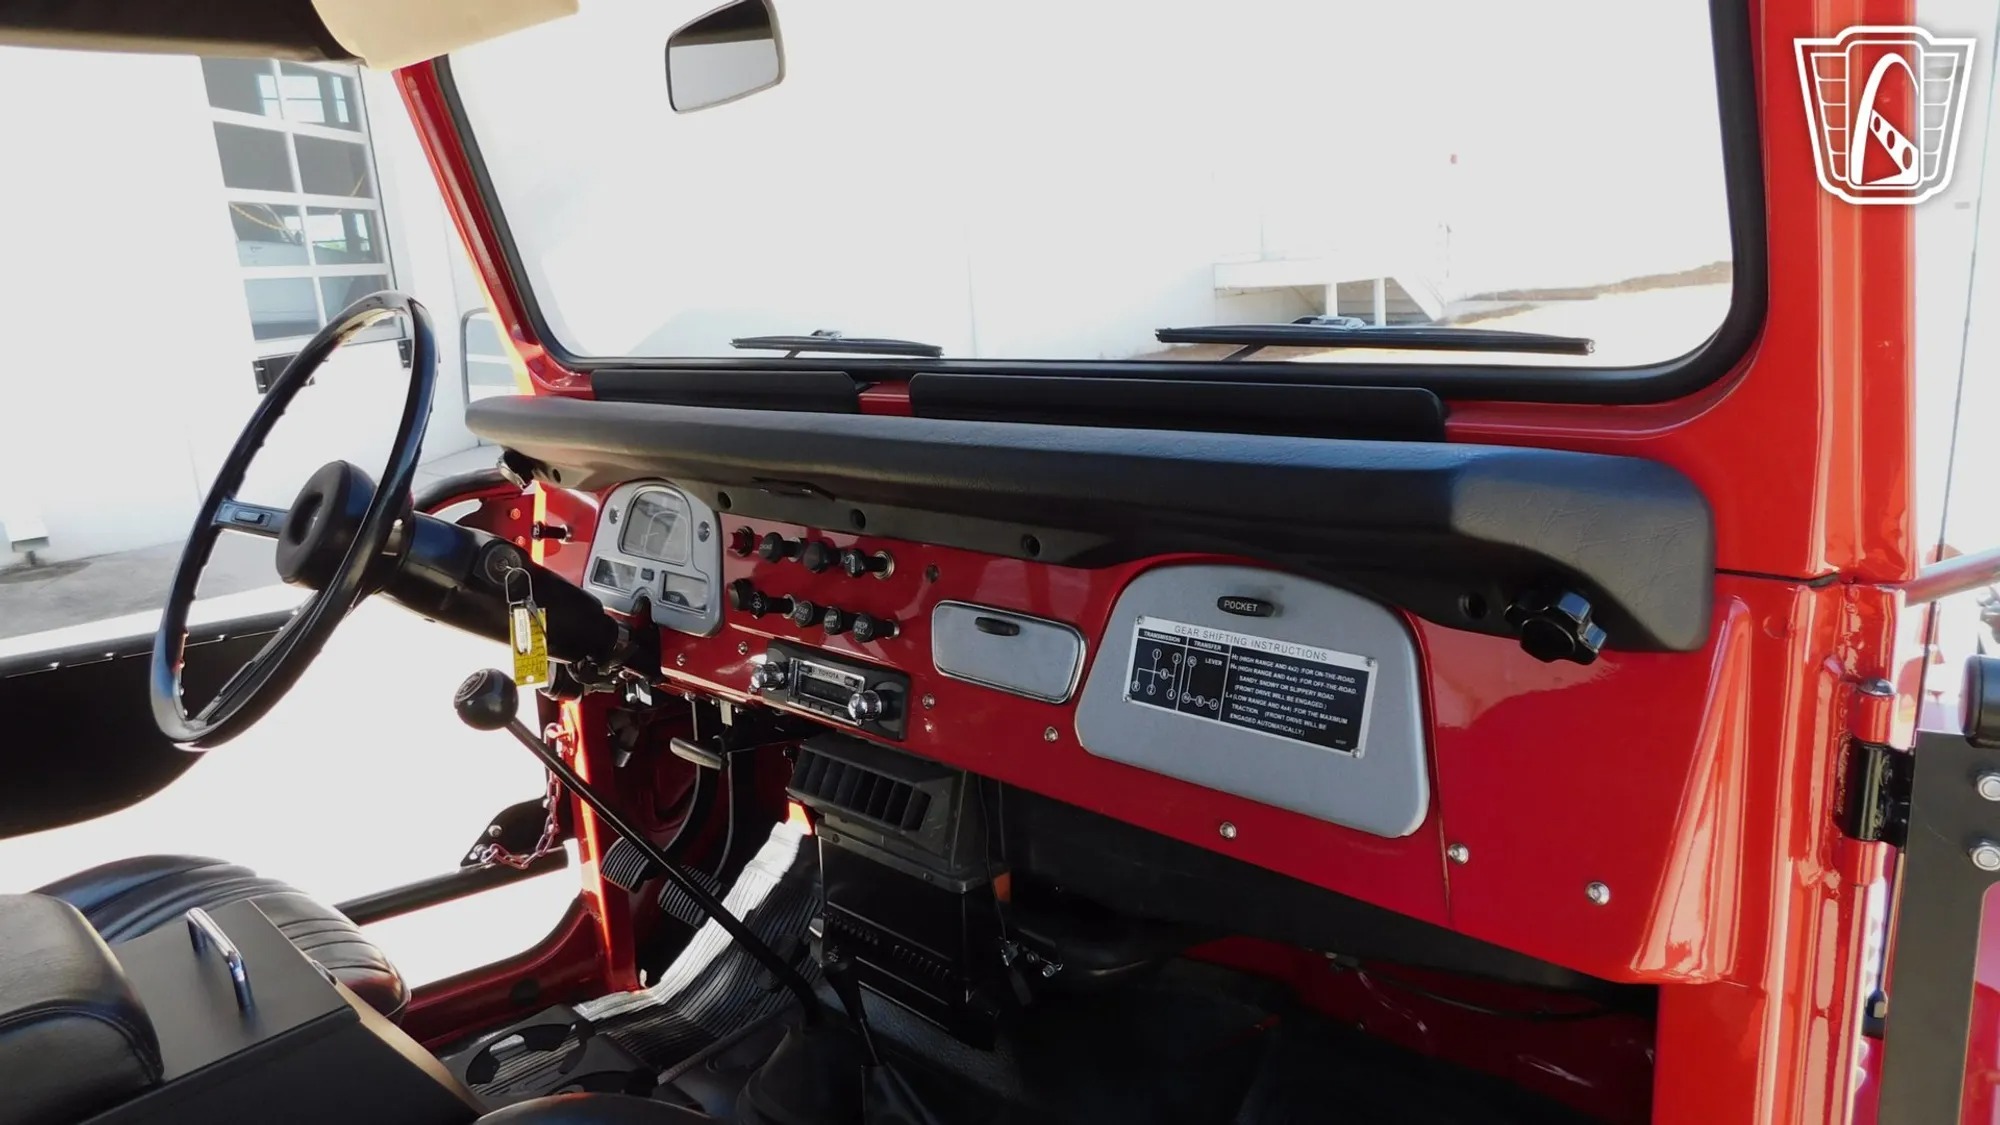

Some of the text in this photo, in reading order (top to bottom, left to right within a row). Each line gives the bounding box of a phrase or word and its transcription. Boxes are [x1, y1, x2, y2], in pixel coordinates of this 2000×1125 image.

[1224, 600, 1258, 612] POCKET
[1143, 630, 1181, 643] TRANSMISSION
[1174, 625, 1328, 661] GEAR SHIFTING INSTRUCTIONS
[1193, 640, 1222, 651] TRANSFER
[1204, 658, 1223, 666] LEVER
[1254, 659, 1274, 668] RANGE
[1274, 662, 1288, 670] AND
[1253, 668, 1272, 677] RANGE
[1273, 672, 1286, 680] AND
[1255, 688, 1271, 697] DRIVE
[1271, 692, 1286, 700] WILL
[1259, 680, 1280, 689] SNOWY
[1289, 686, 1316, 697] SLIPPERY
[1248, 697, 1267, 706] RANGE
[1267, 701, 1280, 709] AND
[1307, 710, 1319, 718] THE
[1319, 713, 1348, 724] MAXIMUM
[1230, 713, 1257, 724] ENGAGED
[1286, 716, 1303, 725] DRIVE
[1303, 720, 1318, 728] WILL
